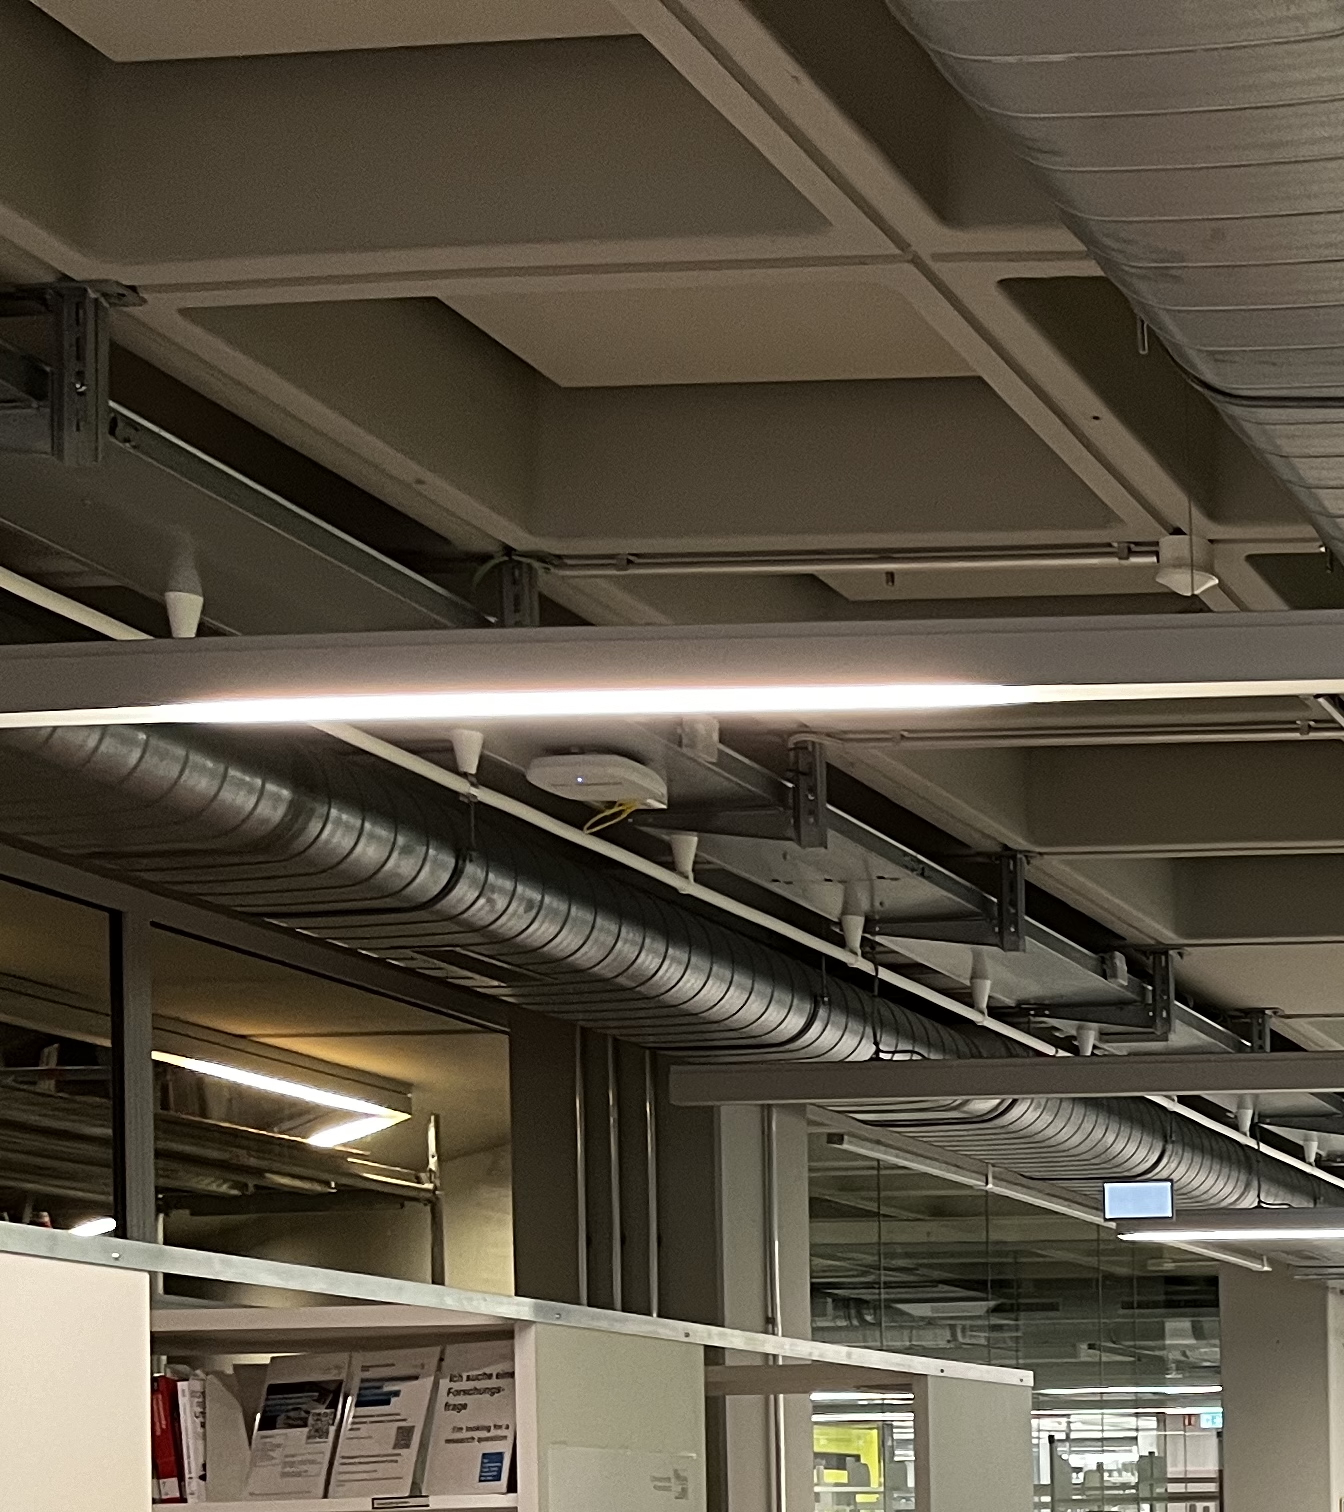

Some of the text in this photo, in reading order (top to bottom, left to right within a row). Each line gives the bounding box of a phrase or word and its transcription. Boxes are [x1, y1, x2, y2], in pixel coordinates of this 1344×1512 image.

[466, 1372, 493, 1381] suche
[447, 1386, 505, 1397] Forschungs-
[444, 1401, 468, 1413] frage
[465, 1425, 491, 1433] looking
